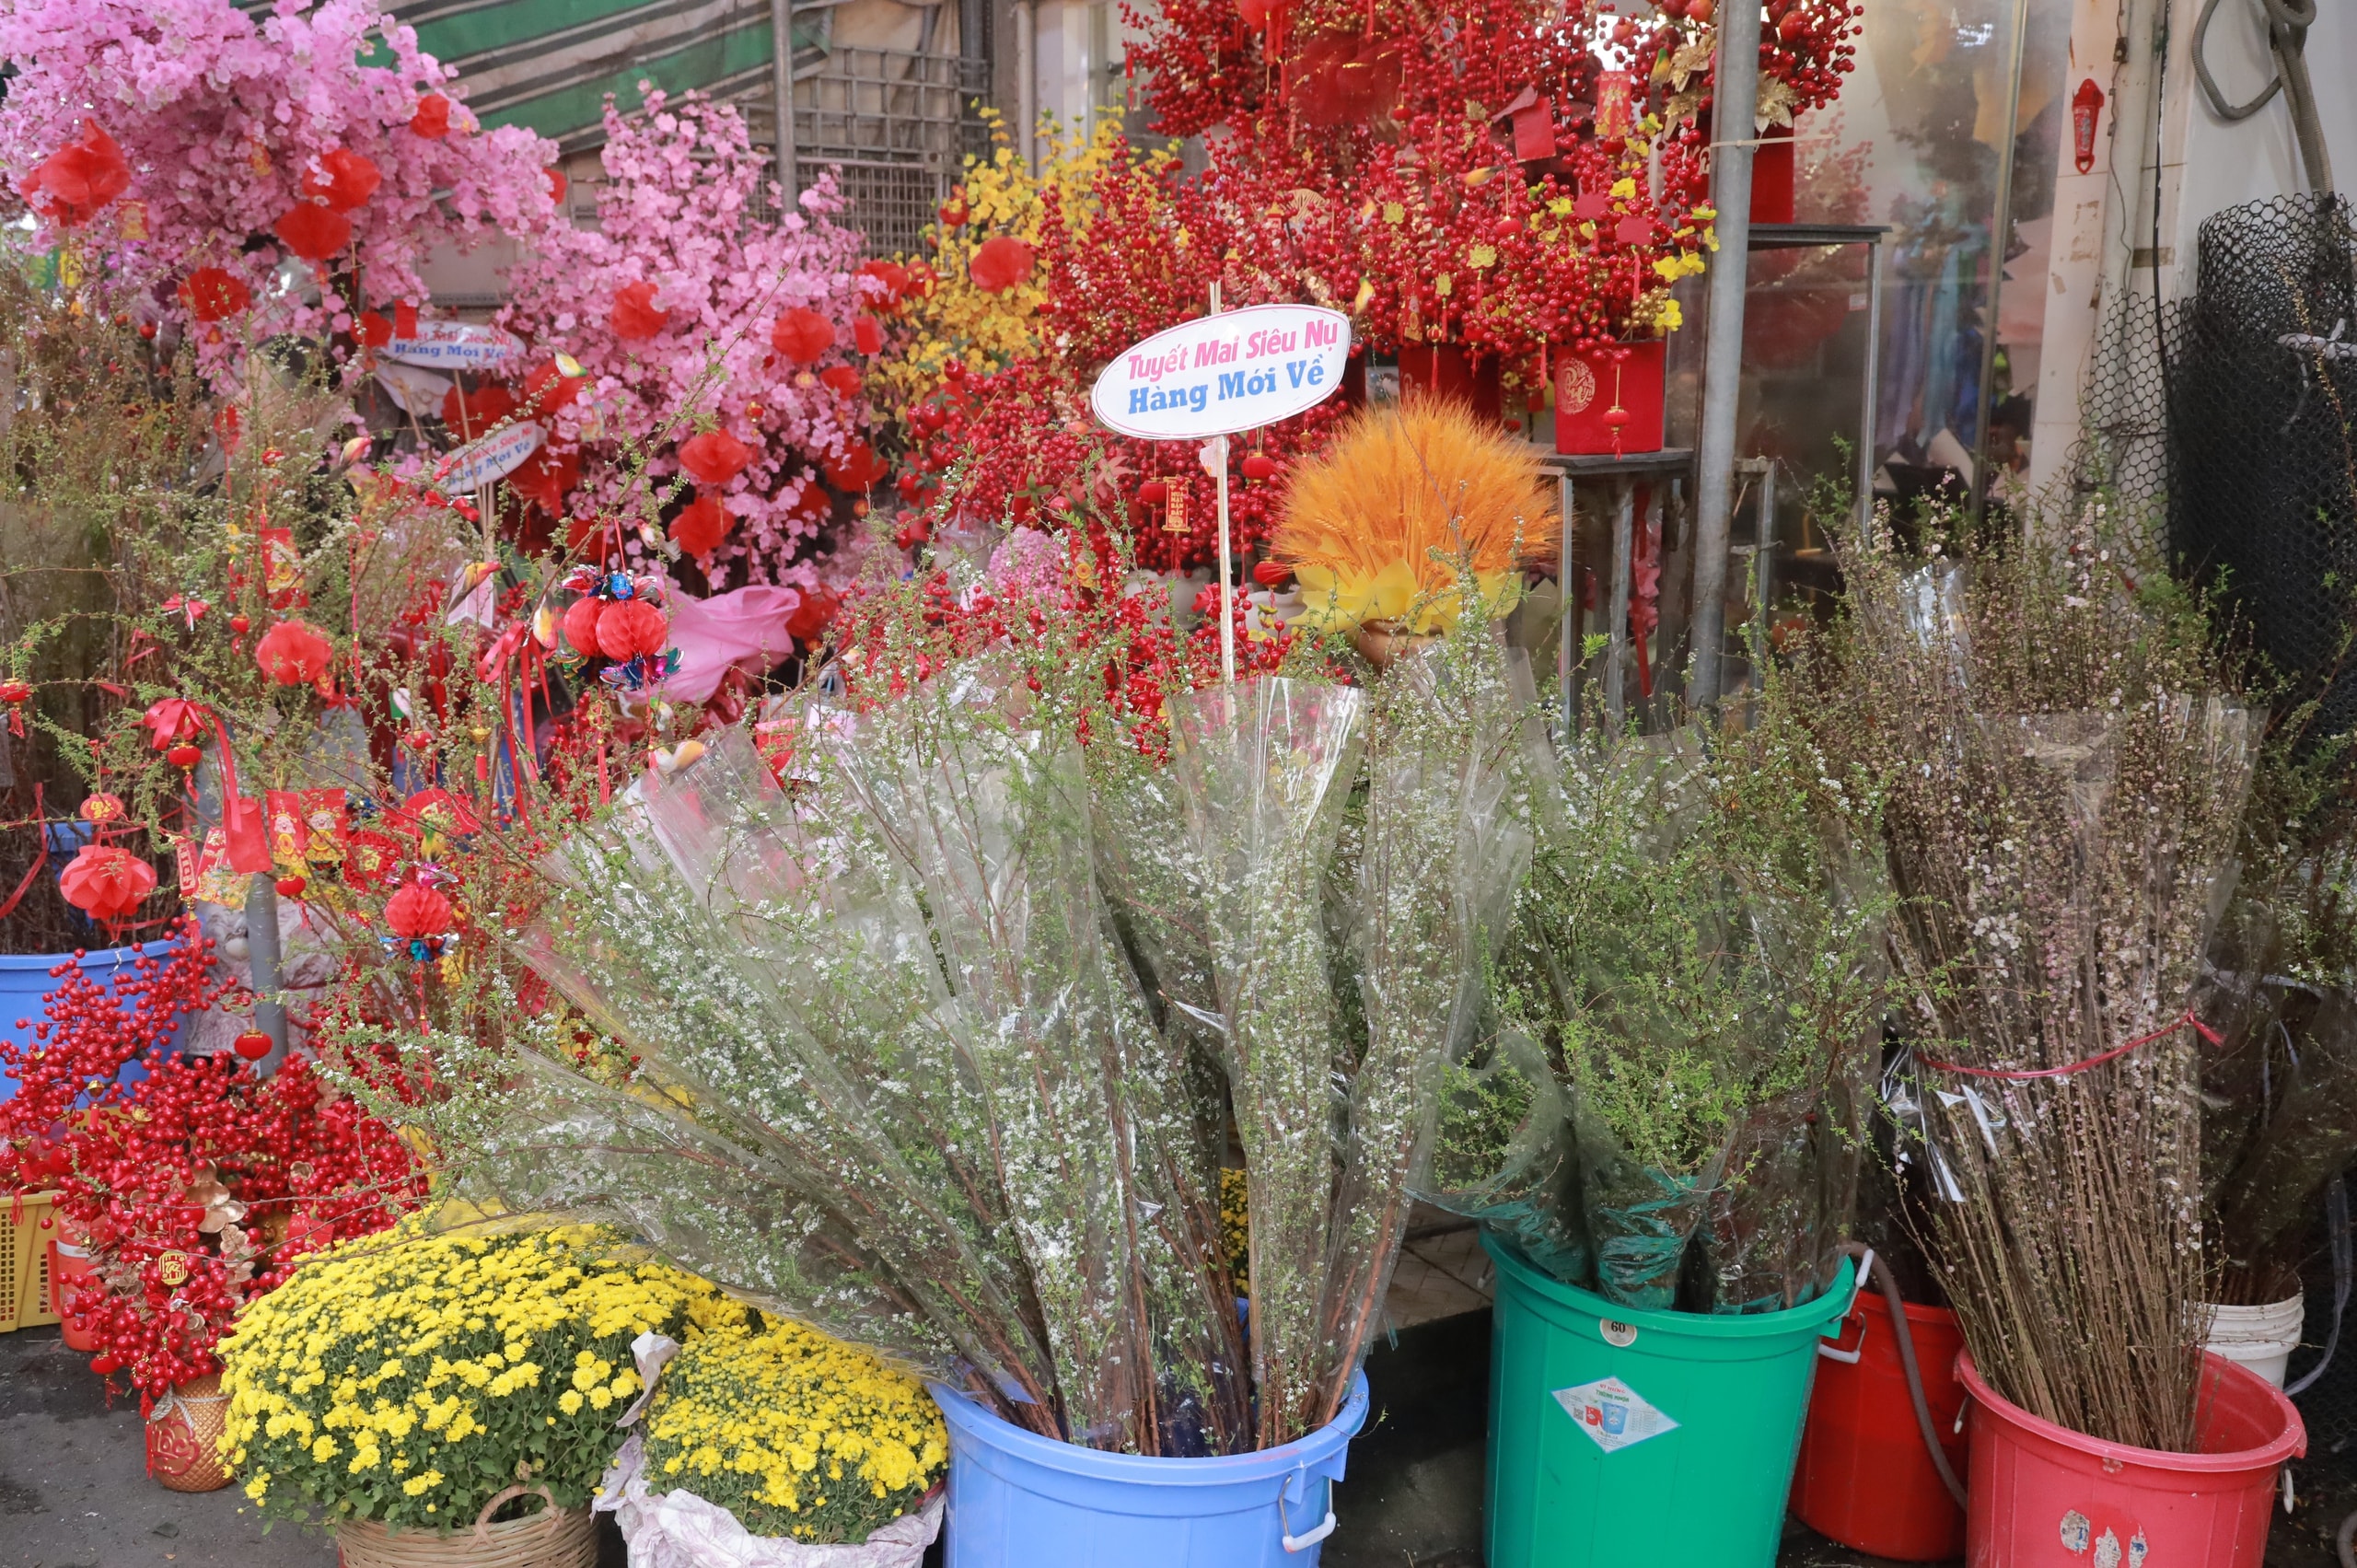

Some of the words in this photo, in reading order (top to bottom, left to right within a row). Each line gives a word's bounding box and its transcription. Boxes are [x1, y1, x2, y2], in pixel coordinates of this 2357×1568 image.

[1128, 343, 1189, 383] Tuyết
[1194, 335, 1239, 368] Mai
[1246, 328, 1297, 360] Siêu
[1304, 319, 1338, 353] Nụ
[1128, 383, 1209, 414] Hàng
[1218, 366, 1277, 401] Mới
[1286, 354, 1325, 389] Về
[1611, 1320, 1626, 1334] 60
